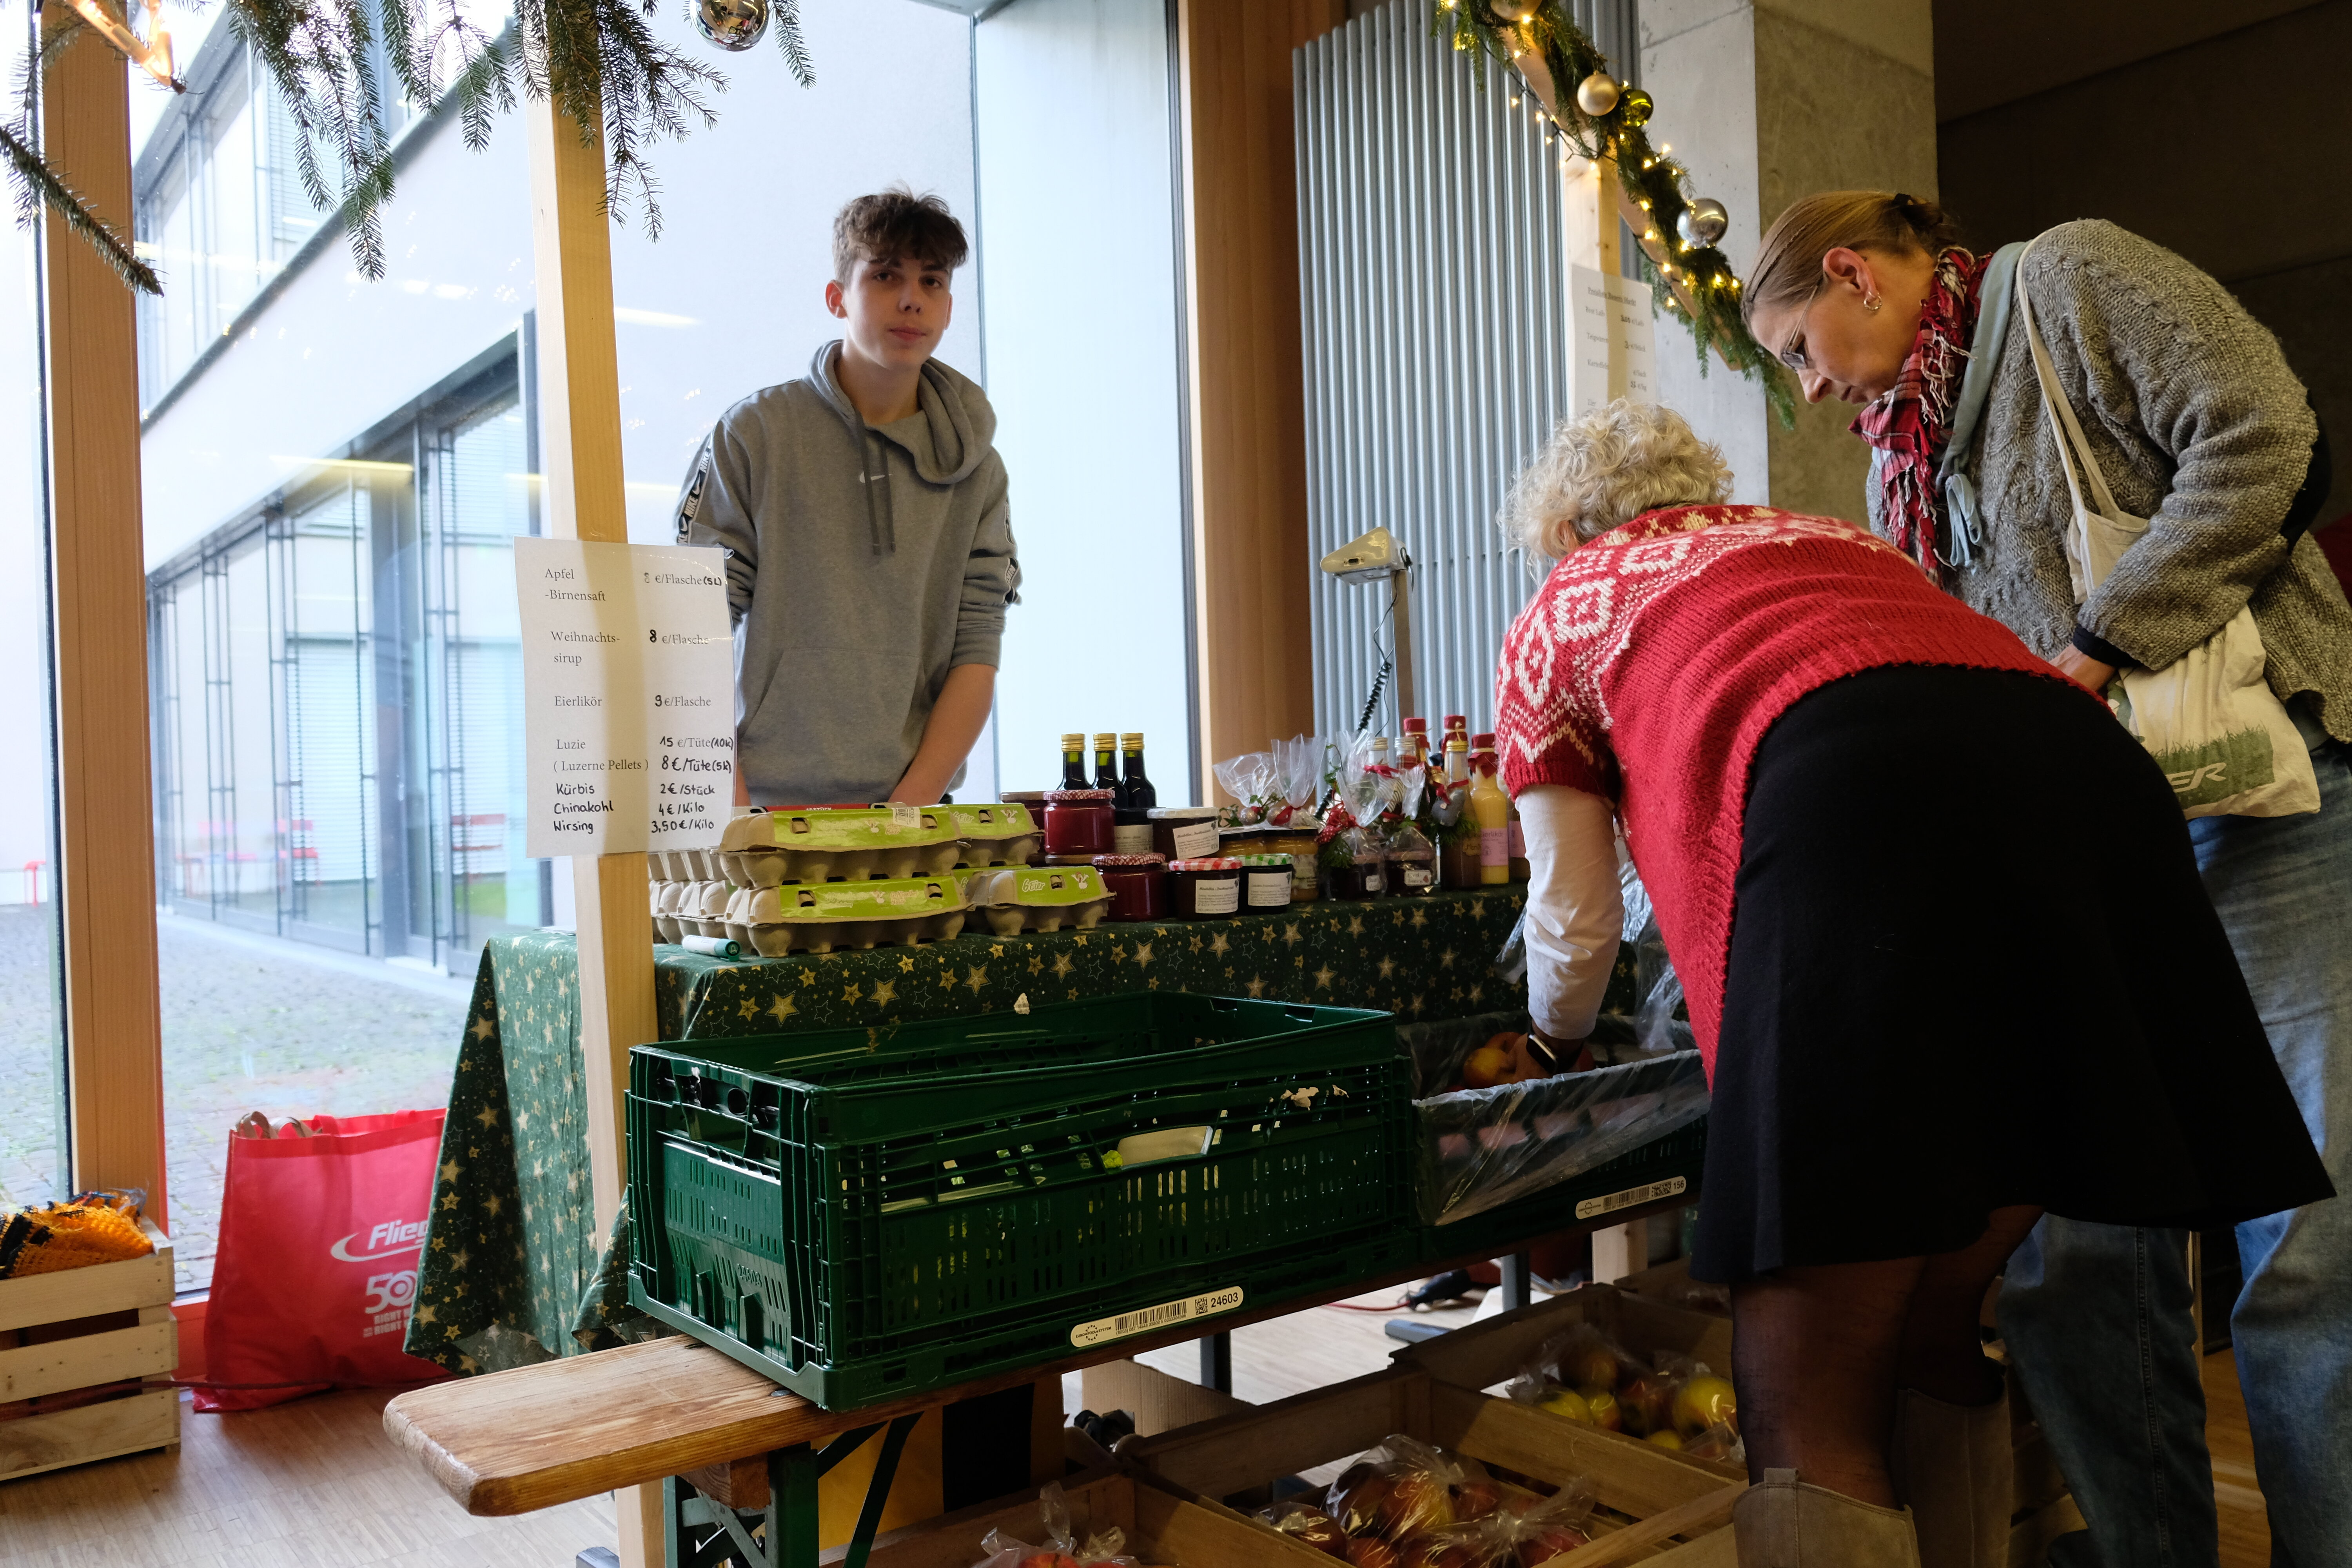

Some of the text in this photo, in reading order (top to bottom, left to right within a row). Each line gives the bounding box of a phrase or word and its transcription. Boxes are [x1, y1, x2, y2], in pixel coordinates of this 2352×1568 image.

[699, 451, 711, 473] NIKE
[684, 495, 699, 517] NIKE
[545, 568, 574, 581] Apfel
[545, 589, 606, 601] -Birnensaft
[550, 631, 621, 643] Weihnachts-
[649, 629, 710, 645] 8 €/Flasche
[554, 653, 582, 666] sirup
[555, 696, 603, 706] Eierlikör
[655, 695, 711, 707] 9 €/Flasche
[557, 739, 586, 749] Luzie
[660, 736, 673, 747] 15
[561, 761, 605, 771] Luzerne
[608, 759, 642, 770] Pellets
[556, 782, 595, 795] Kürbis
[554, 800, 614, 814] Chinakohl
[554, 820, 594, 835] Wirsing
[1673, 1180, 1684, 1190] 156
[365, 1270, 417, 1314] 50
[1211, 1292, 1238, 1308] 24603
[374, 1310, 402, 1325] RIGHT
